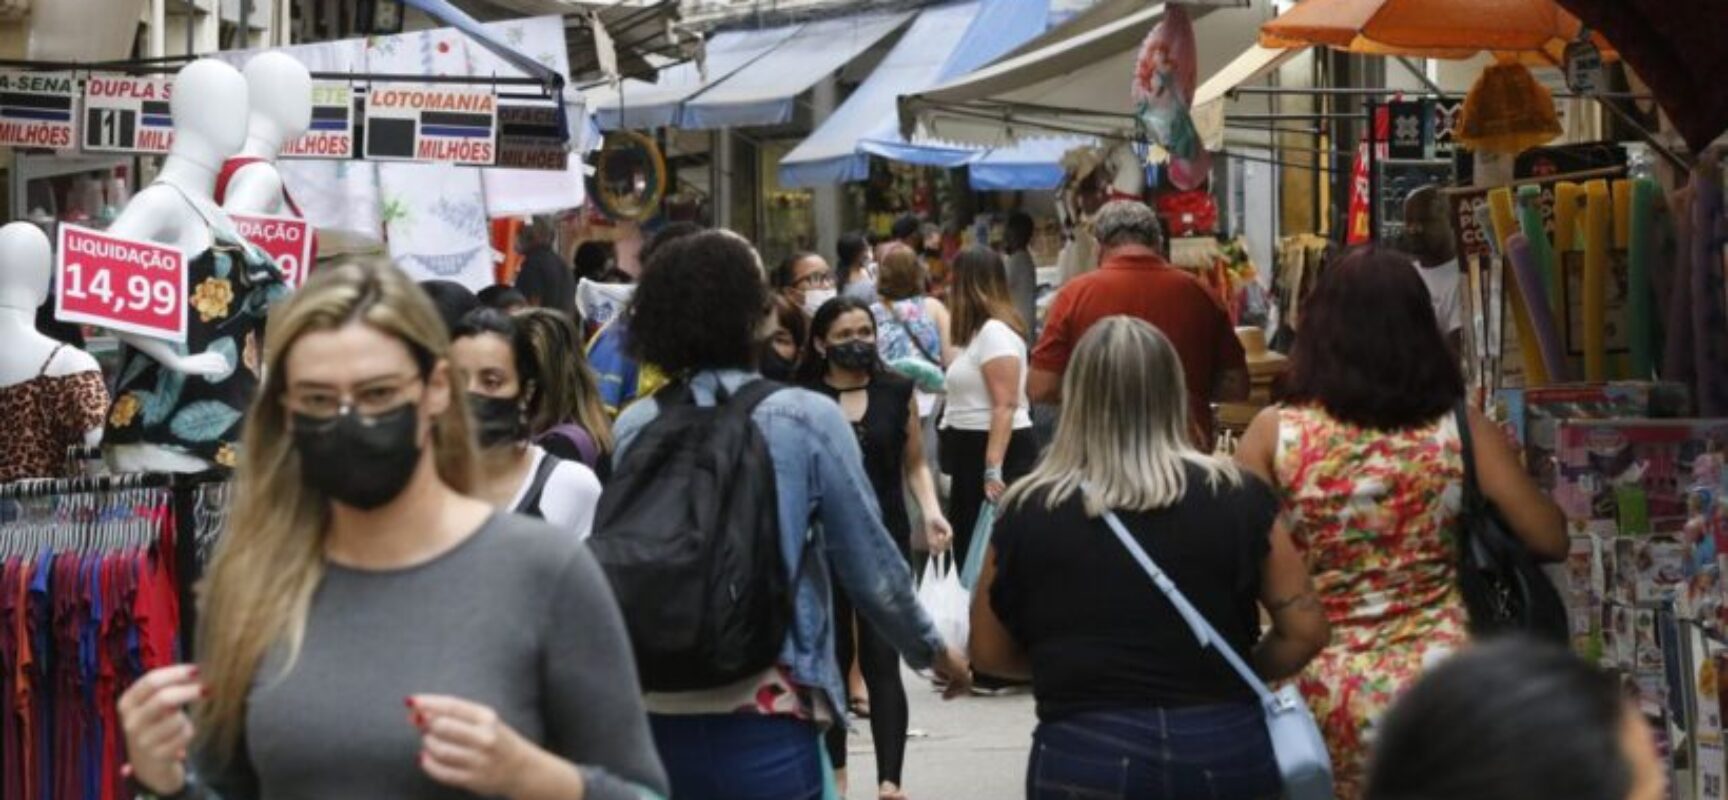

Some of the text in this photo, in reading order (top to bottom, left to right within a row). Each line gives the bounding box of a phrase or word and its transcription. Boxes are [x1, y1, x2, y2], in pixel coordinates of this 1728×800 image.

[90, 79, 155, 98] DUPLA
[311, 86, 347, 104] ETE
[371, 89, 493, 111] LOTOMANIA
[138, 130, 174, 150] MILH
[418, 137, 492, 161] MILHÕES
[240, 222, 300, 242] DAÇÃO
[68, 234, 176, 271] LIQUIDAÇÃO
[276, 254, 298, 286] 9
[65, 263, 176, 315] 14,99
